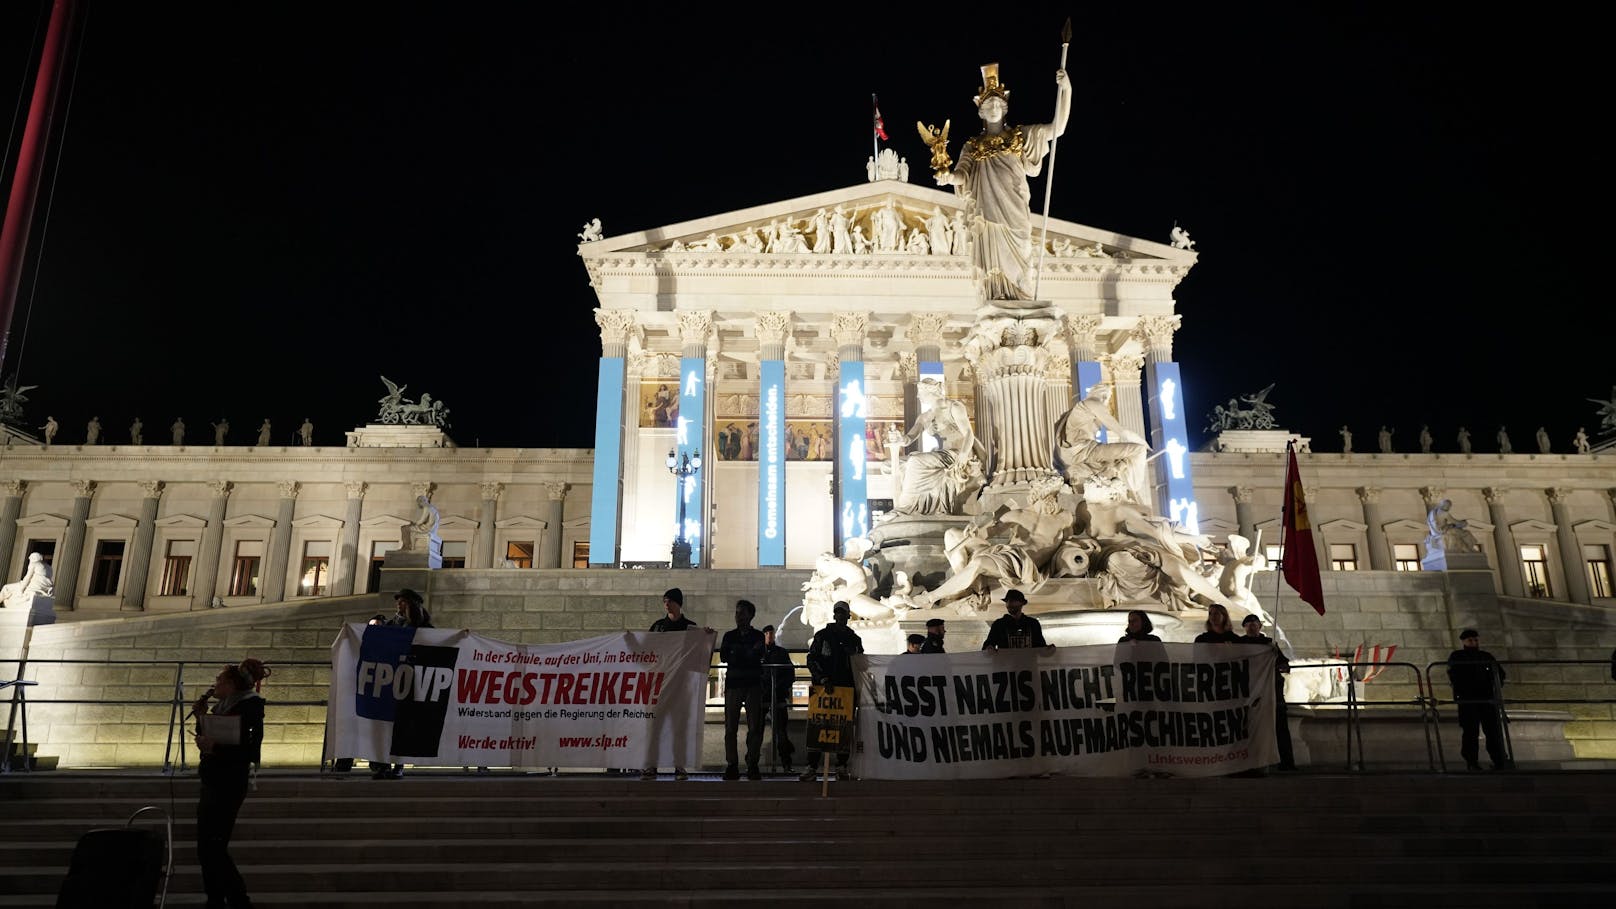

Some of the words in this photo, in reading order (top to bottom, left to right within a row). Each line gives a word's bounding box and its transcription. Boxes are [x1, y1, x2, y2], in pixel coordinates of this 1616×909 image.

[766, 384, 778, 463] entscheiden.
[765, 464, 777, 539] Gemeinsam
[473, 649, 484, 662] In
[485, 650, 503, 663] der
[545, 654, 561, 667] auf
[564, 654, 580, 665] der
[604, 651, 616, 663] im
[619, 651, 659, 664] Betrieb:
[457, 668, 665, 705] WEGSTREIKEN!
[953, 670, 1035, 714] NAZIS
[1040, 665, 1115, 712] NICHT
[1120, 659, 1249, 702] REGIEREN
[458, 707, 511, 718] Widerstand
[514, 710, 542, 721] gegen
[544, 709, 558, 719] die
[560, 709, 605, 721] Regierung
[606, 709, 620, 719] der
[623, 709, 656, 719] Reichen.
[458, 735, 497, 750] Werde
[499, 735, 536, 750] aktiv!
[559, 735, 627, 751] www.slp.at
[878, 721, 927, 763] UND
[931, 721, 1035, 763] NIEMALS
[1041, 706, 1250, 756] AUFMARSCHIEREN!
